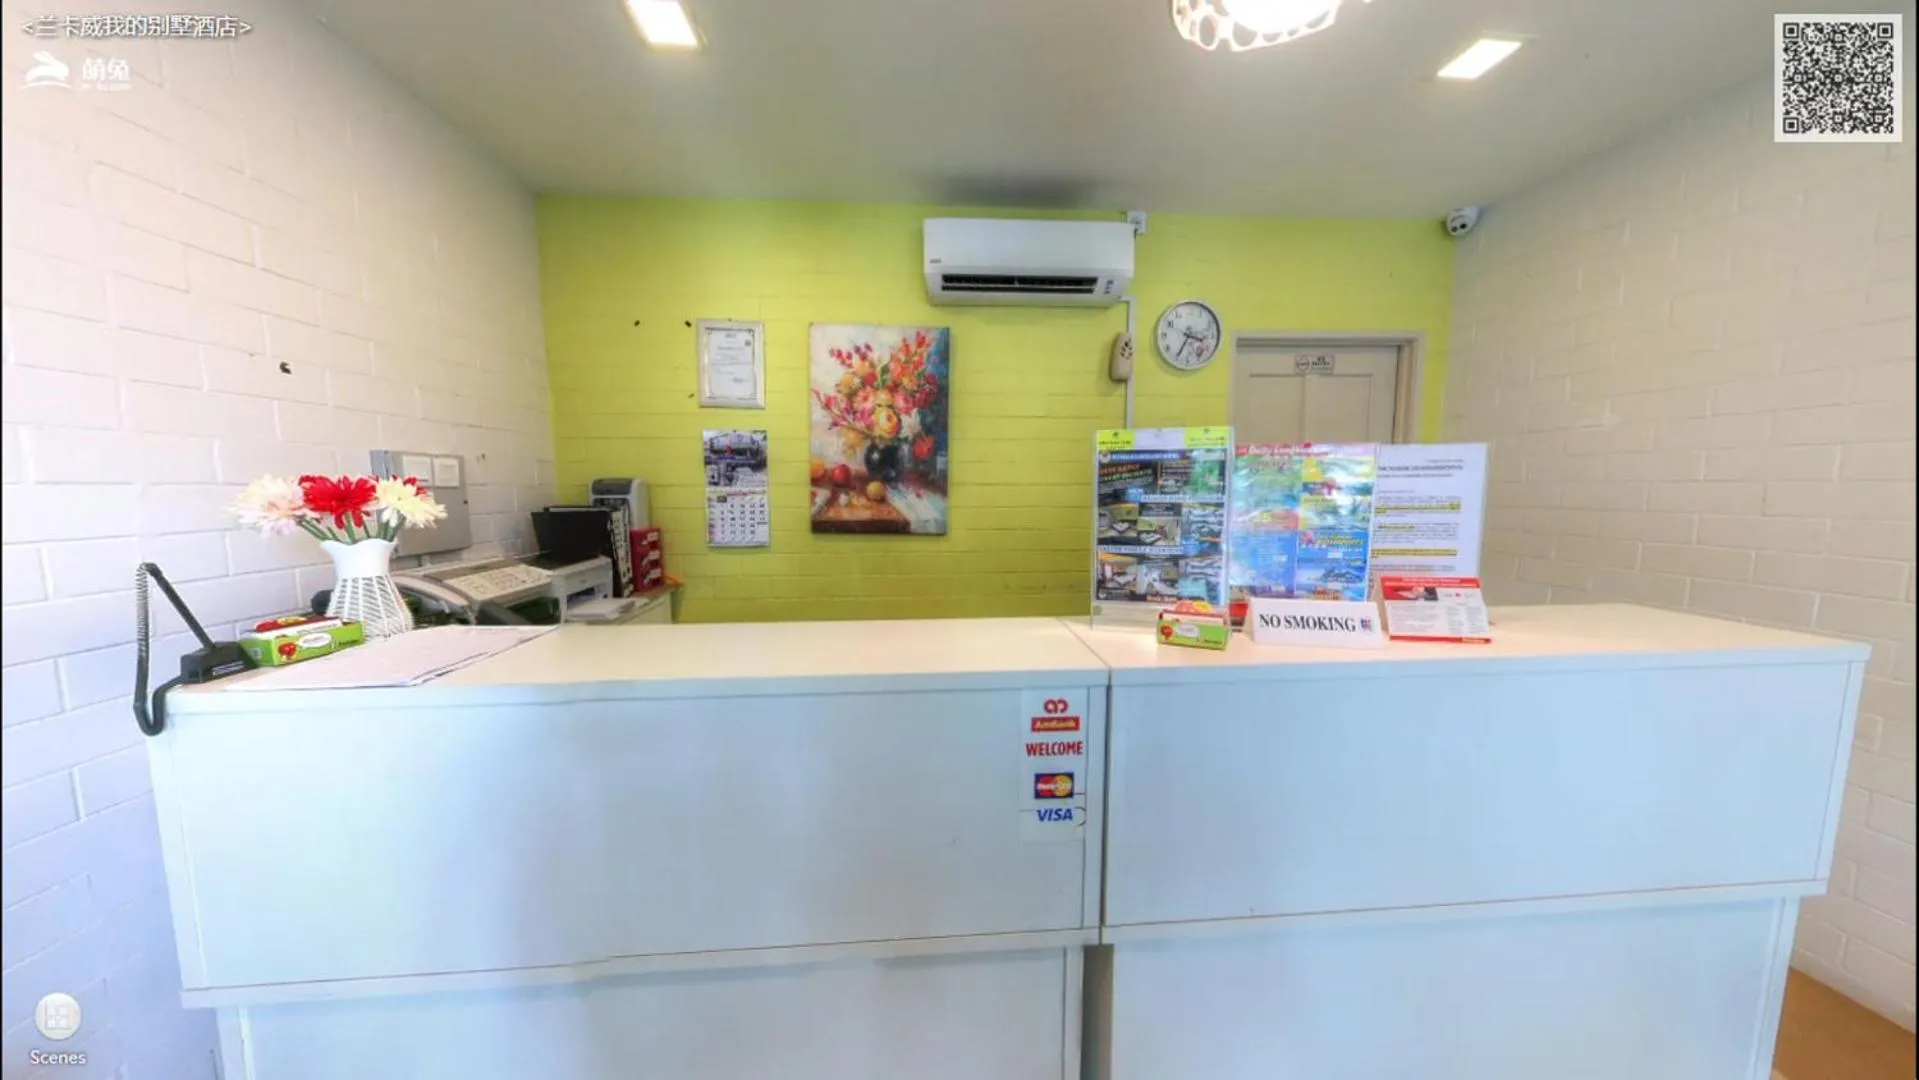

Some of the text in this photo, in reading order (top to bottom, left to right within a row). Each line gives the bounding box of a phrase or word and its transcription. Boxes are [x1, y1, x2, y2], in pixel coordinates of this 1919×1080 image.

[1259, 613, 1356, 632] NO SMOKING
[1026, 741, 1084, 757] WELCOME
[1036, 808, 1074, 822] VISA
